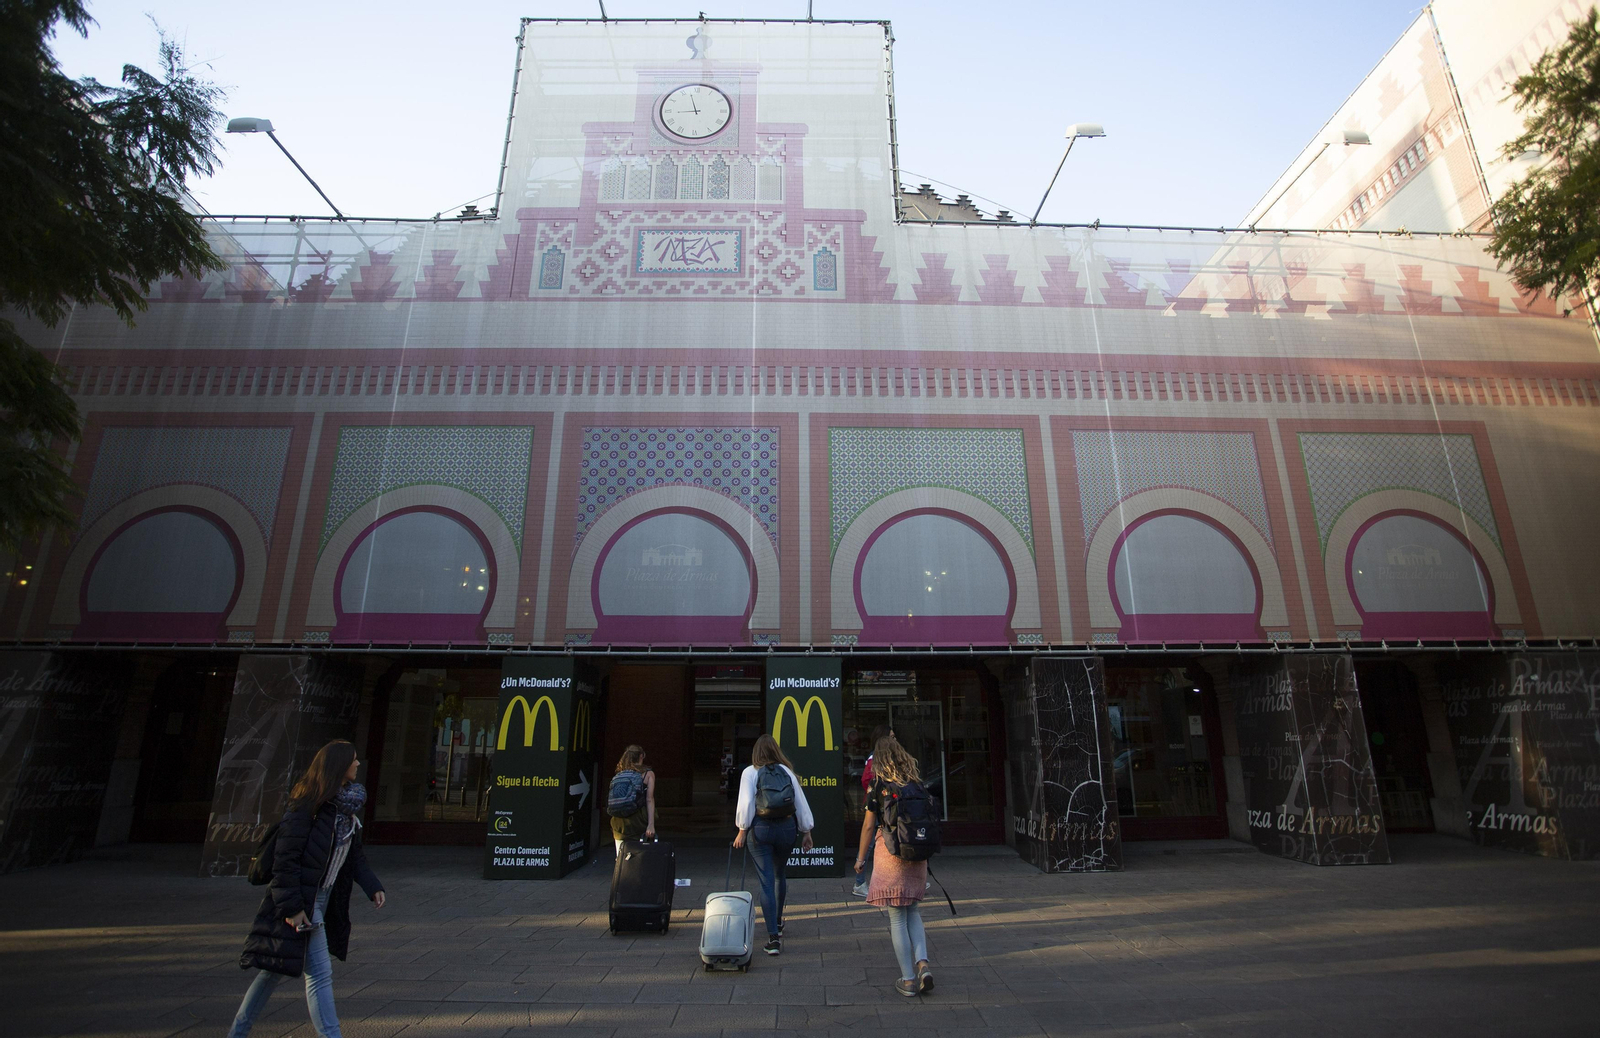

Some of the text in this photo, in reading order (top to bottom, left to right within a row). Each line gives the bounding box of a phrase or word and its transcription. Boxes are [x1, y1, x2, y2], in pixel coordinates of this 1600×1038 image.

[625, 567, 719, 581] Plaza de Armas
[501, 677, 518, 689] ¿Un
[518, 677, 572, 688] McDonald's?
[769, 677, 840, 690] ¿Un McDonald's?
[1487, 678, 1506, 697] de
[1508, 674, 1571, 695] Armas
[1241, 693, 1293, 714] Armas
[1492, 700, 1566, 713] Plaza de Armas
[1460, 735, 1514, 744] Plaza de Armas
[496, 775, 560, 788] Sigue la flecha
[809, 775, 837, 787] flecha
[1277, 804, 1296, 832] de
[1298, 806, 1382, 835] Armas
[1477, 802, 1558, 835] Armas
[1027, 810, 1037, 838] de
[1038, 812, 1118, 842] Armas
[494, 846, 550, 855] Centro Comercial
[493, 857, 550, 866] PLAZA DE ARMAS
[786, 857, 834, 866] AZA DE ARMAS
